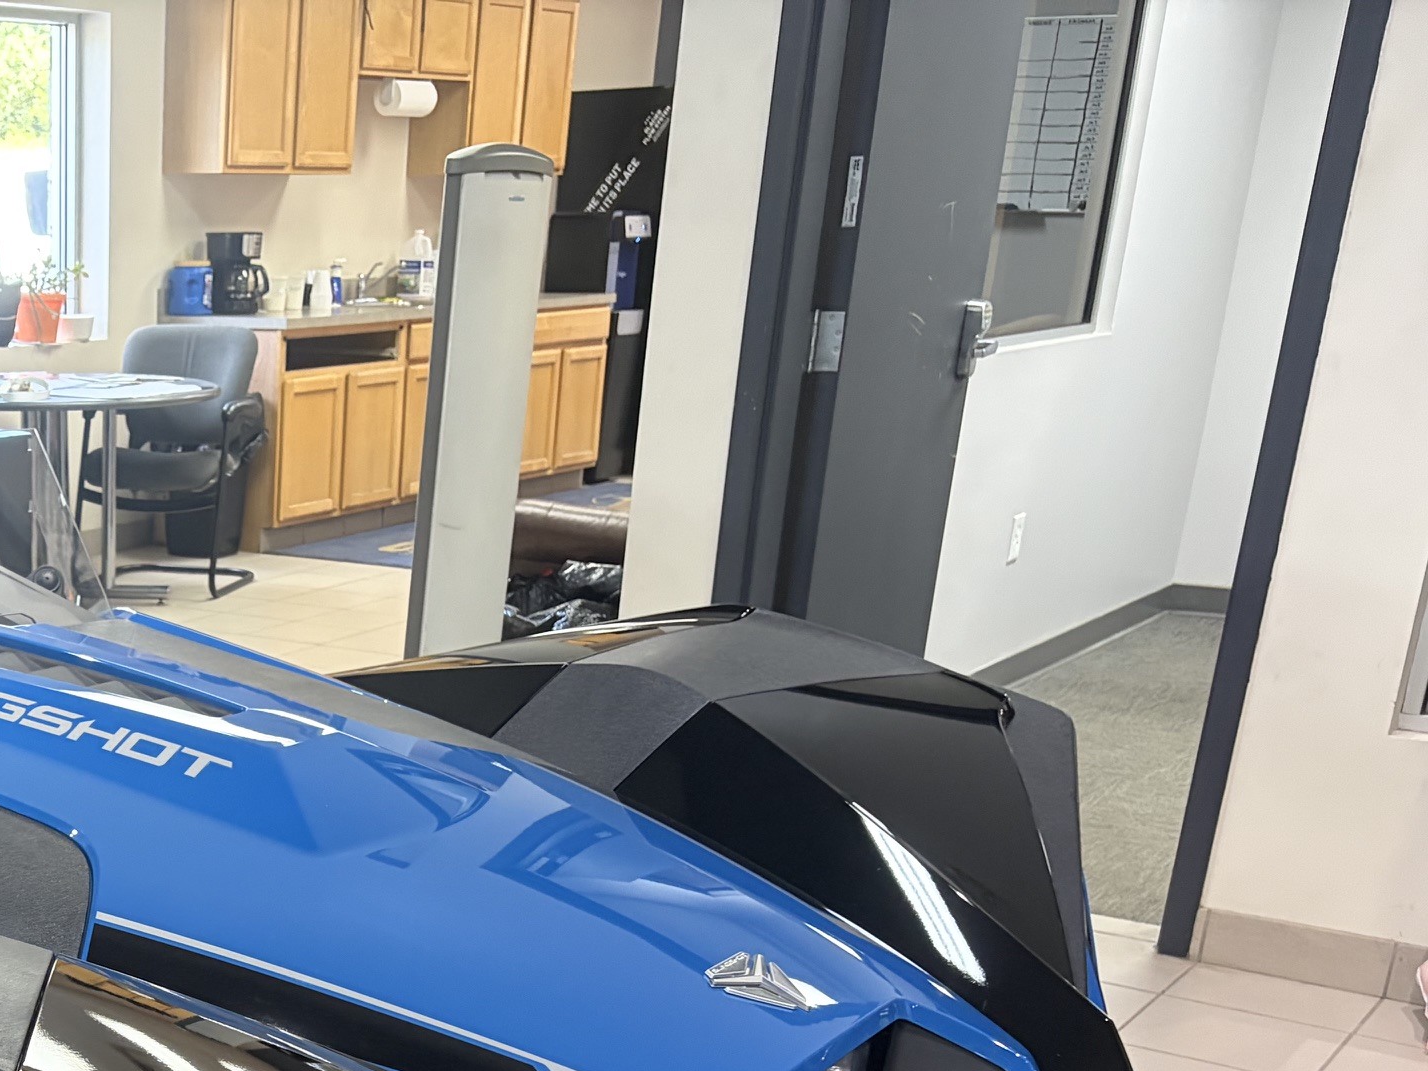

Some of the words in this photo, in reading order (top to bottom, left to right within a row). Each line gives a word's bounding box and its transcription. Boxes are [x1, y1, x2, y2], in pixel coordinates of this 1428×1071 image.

[594, 183, 609, 198] TO
[604, 162, 622, 187] PUT
[602, 189, 618, 209] ITS
[613, 157, 641, 193] PLACE
